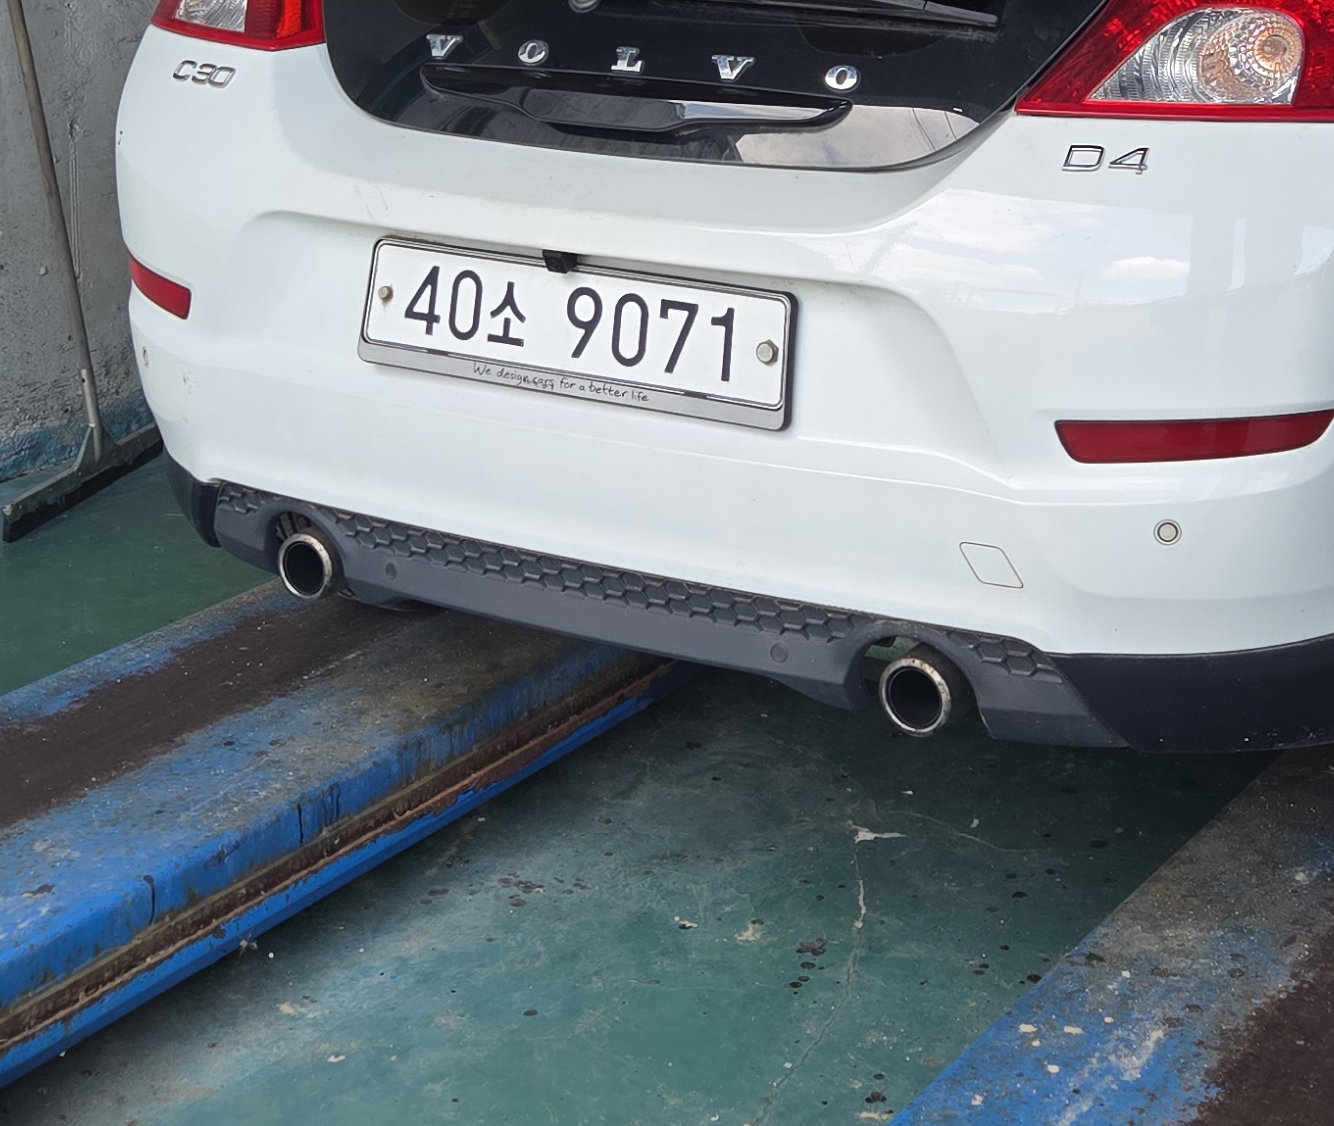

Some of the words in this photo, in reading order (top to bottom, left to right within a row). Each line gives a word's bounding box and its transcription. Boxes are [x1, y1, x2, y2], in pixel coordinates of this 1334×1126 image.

[173, 60, 236, 88] C30
[426, 33, 861, 93] VOLVO
[1061, 145, 1149, 175] D4
[404, 265, 527, 347] 40소
[566, 286, 735, 382] 9071
[473, 363, 492, 376] We
[560, 377, 576, 389] for
[589, 381, 627, 398] better
[631, 388, 650, 402] life
